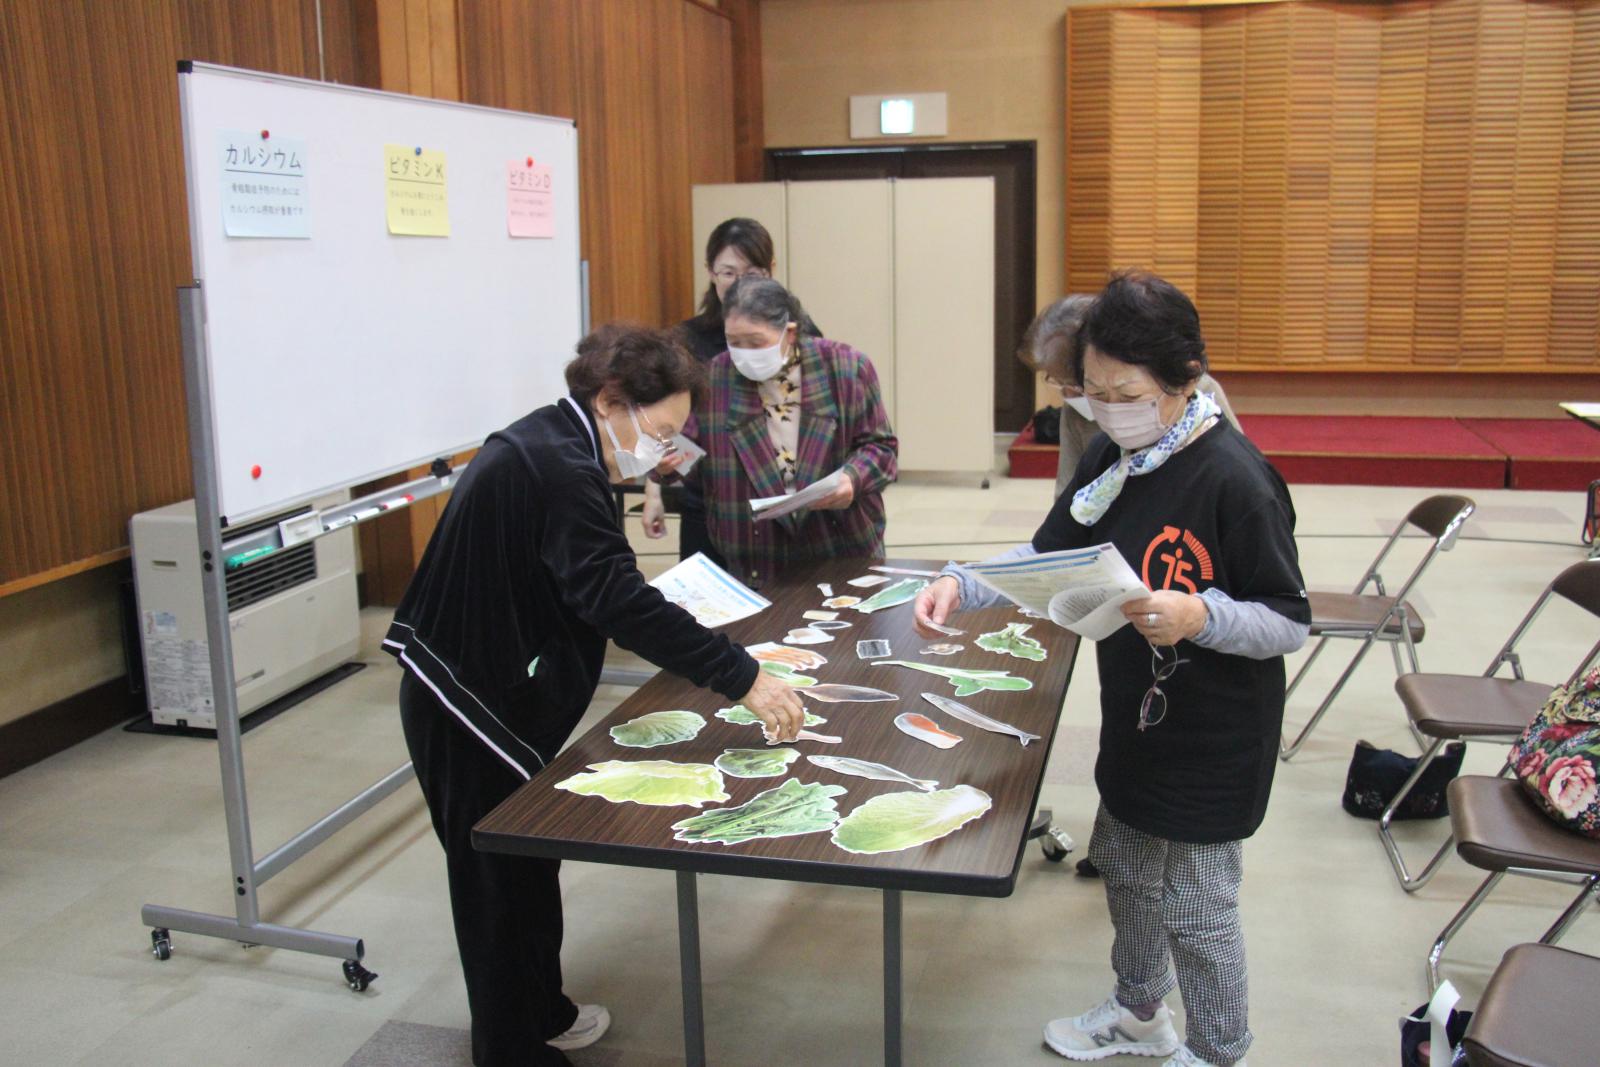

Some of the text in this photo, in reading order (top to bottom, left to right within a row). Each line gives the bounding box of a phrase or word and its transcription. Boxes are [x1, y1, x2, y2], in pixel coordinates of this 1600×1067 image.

[225, 143, 302, 170] カルシウム
[390, 156, 445, 179] ビタミンK
